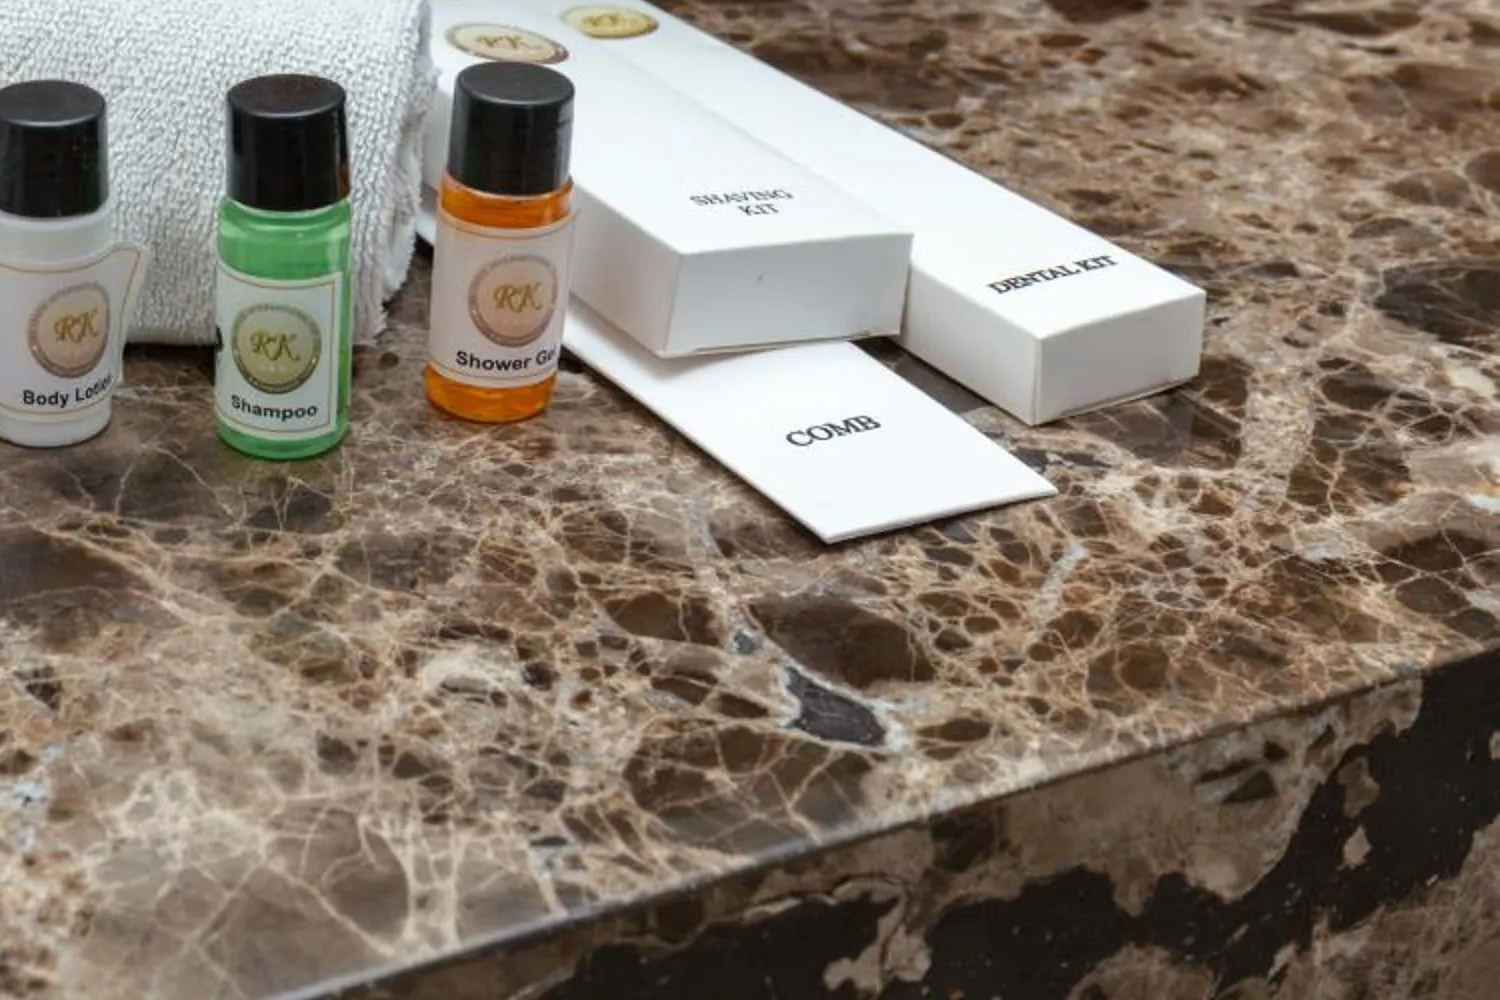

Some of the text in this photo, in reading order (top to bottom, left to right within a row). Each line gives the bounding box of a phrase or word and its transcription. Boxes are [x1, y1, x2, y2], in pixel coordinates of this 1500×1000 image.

[689, 189, 793, 206] SHAVING
[737, 203, 779, 216] KIT
[986, 255, 1118, 295] DENTAL KIT
[456, 346, 557, 371] Shower Ge
[23, 389, 69, 408] Body
[231, 394, 318, 421] Shampoo
[785, 415, 882, 447] COMB
